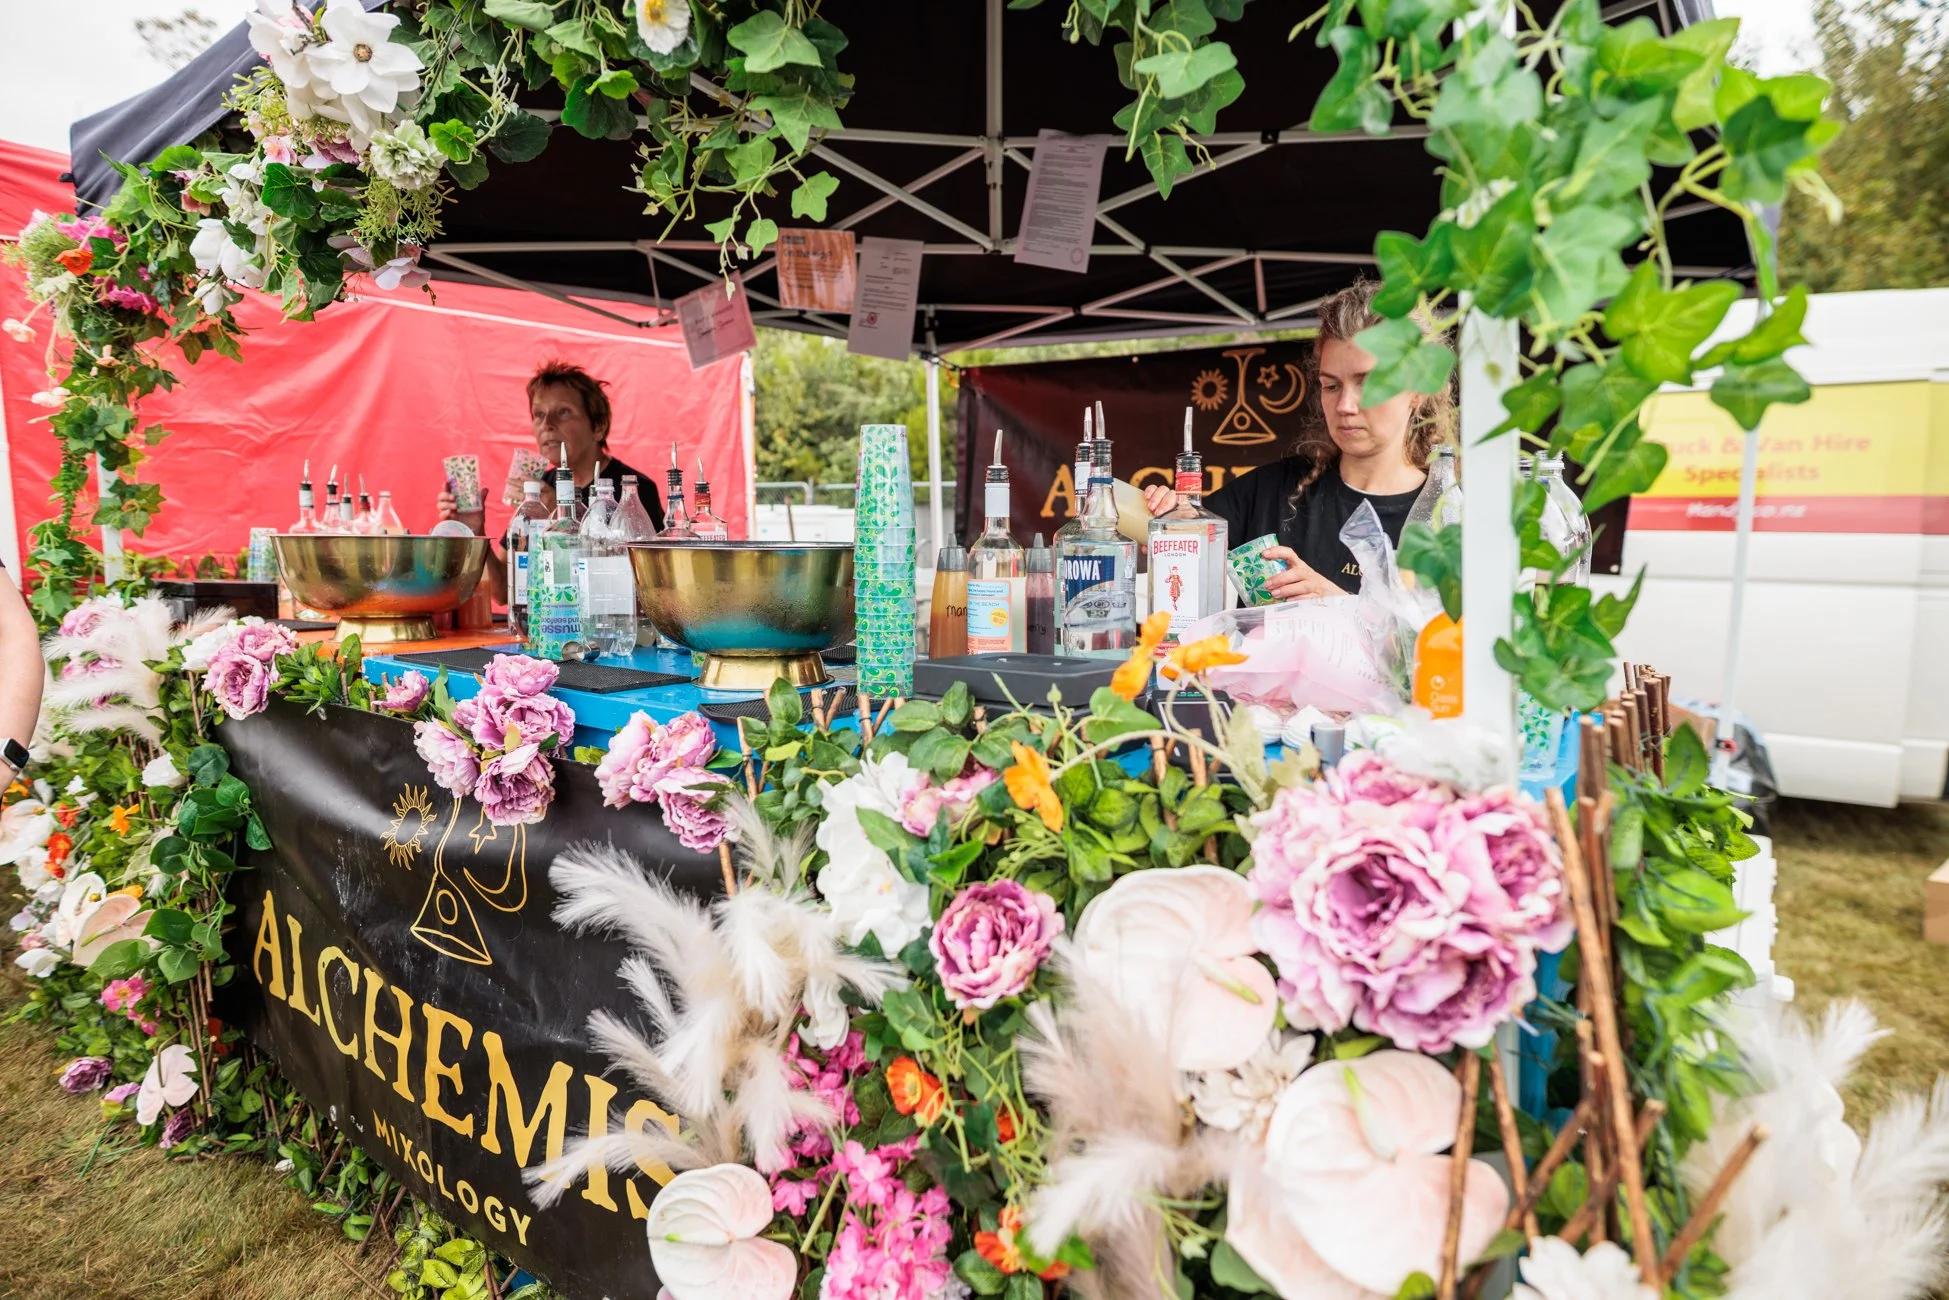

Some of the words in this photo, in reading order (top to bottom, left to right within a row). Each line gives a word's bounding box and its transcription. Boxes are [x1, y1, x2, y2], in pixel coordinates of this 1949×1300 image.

[1812, 435, 1872, 453] Hire
[1684, 463, 1821, 486] Specalists
[1153, 540, 1199, 555] BEEFEATER
[373, 1108, 531, 1247] MIXOLOGY
